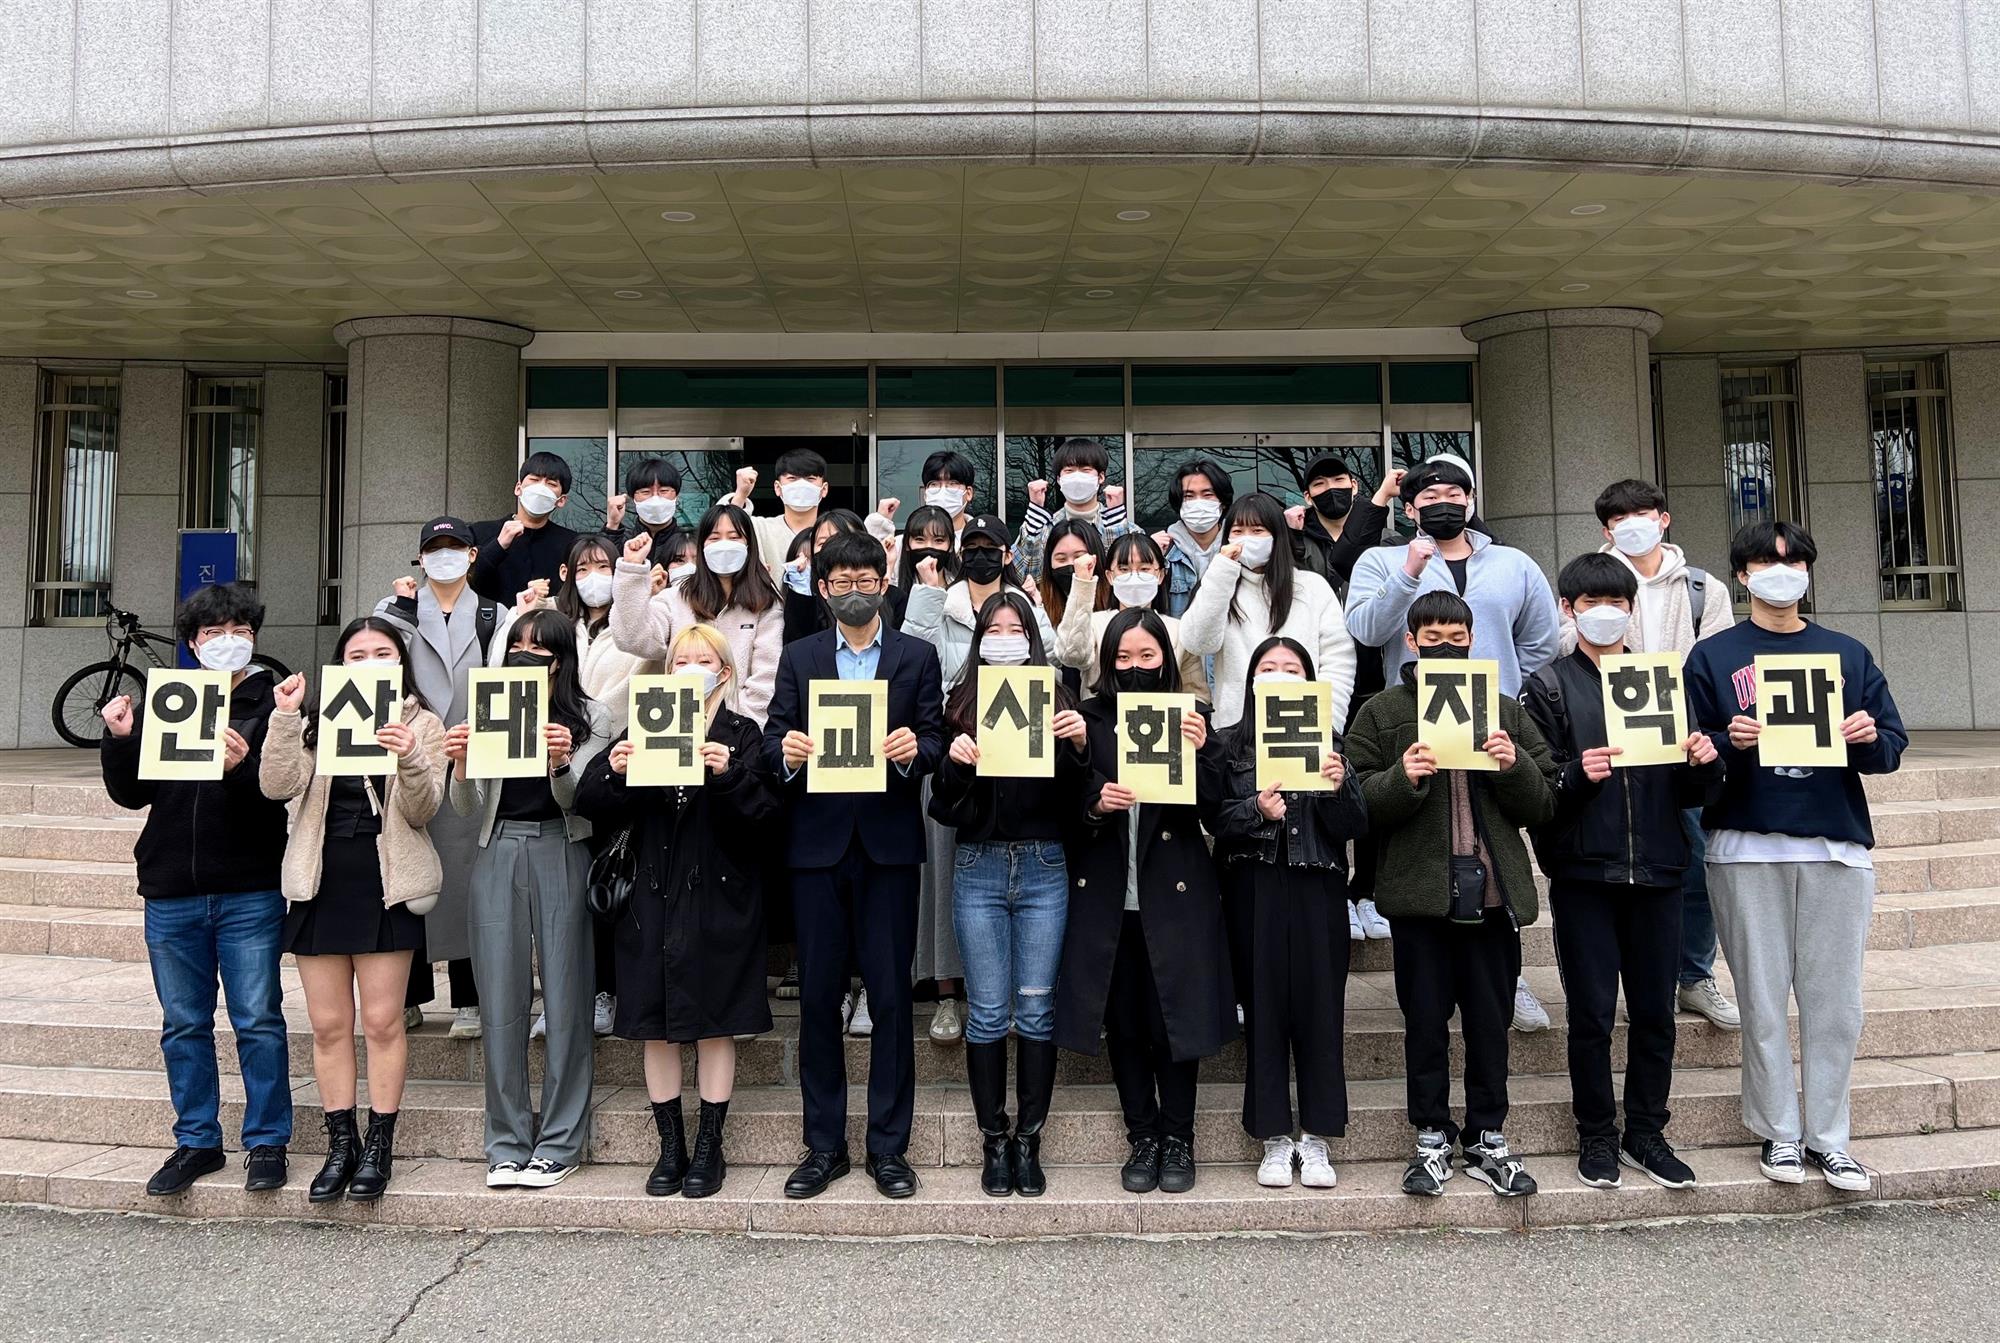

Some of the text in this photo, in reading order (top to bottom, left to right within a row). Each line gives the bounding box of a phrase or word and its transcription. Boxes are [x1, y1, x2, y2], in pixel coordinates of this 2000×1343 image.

[198, 564, 216, 583] 진
[152, 682, 225, 761] 안
[322, 678, 397, 757] 산
[476, 681, 537, 758] 대
[635, 687, 700, 767] 학
[817, 694, 874, 768] 교
[981, 678, 1051, 758] 사
[1263, 695, 1323, 773] 복
[1423, 673, 1487, 752] 지
[1608, 665, 1680, 745] 학
[1764, 669, 1835, 747] 과
[1126, 705, 1182, 785] 회
